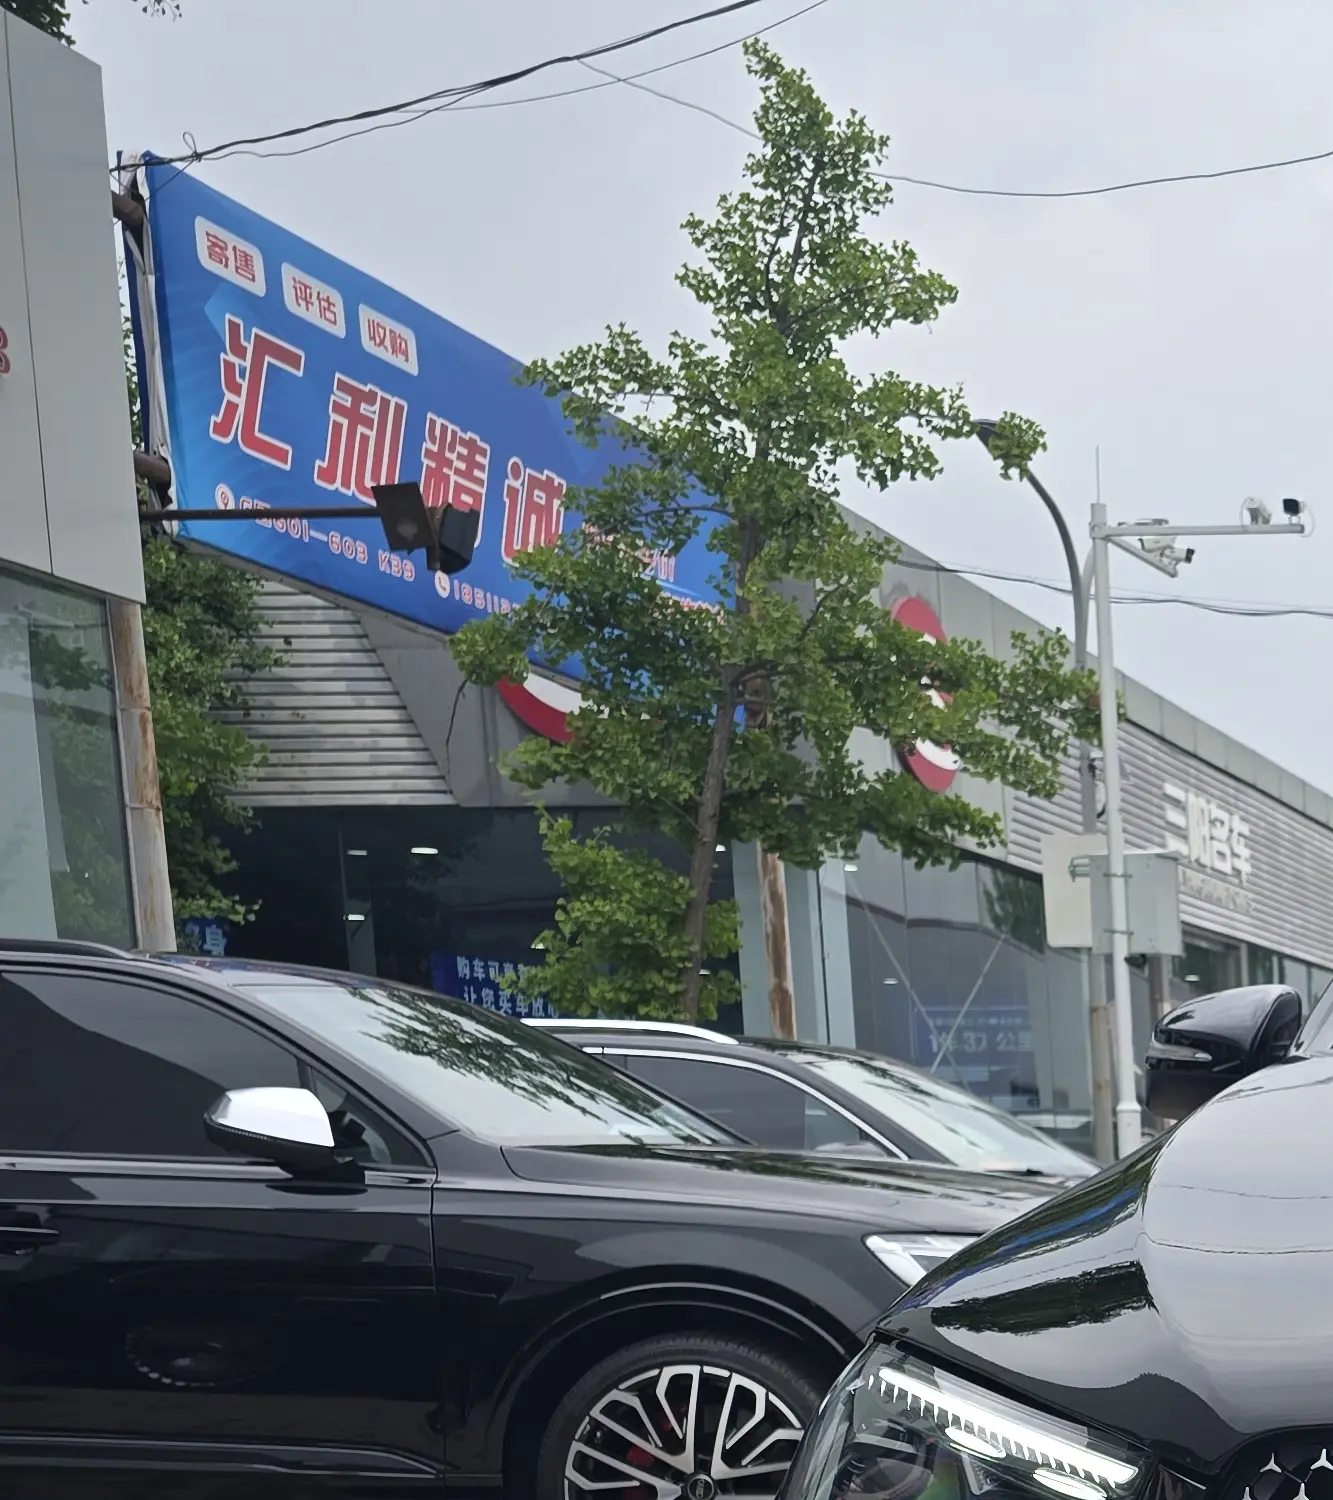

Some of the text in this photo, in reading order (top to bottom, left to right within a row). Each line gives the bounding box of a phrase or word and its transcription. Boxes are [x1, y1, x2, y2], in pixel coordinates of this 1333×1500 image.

[205, 230, 409, 363] 寄售 评估 收购
[209, 313, 566, 566] 汇利精诚
